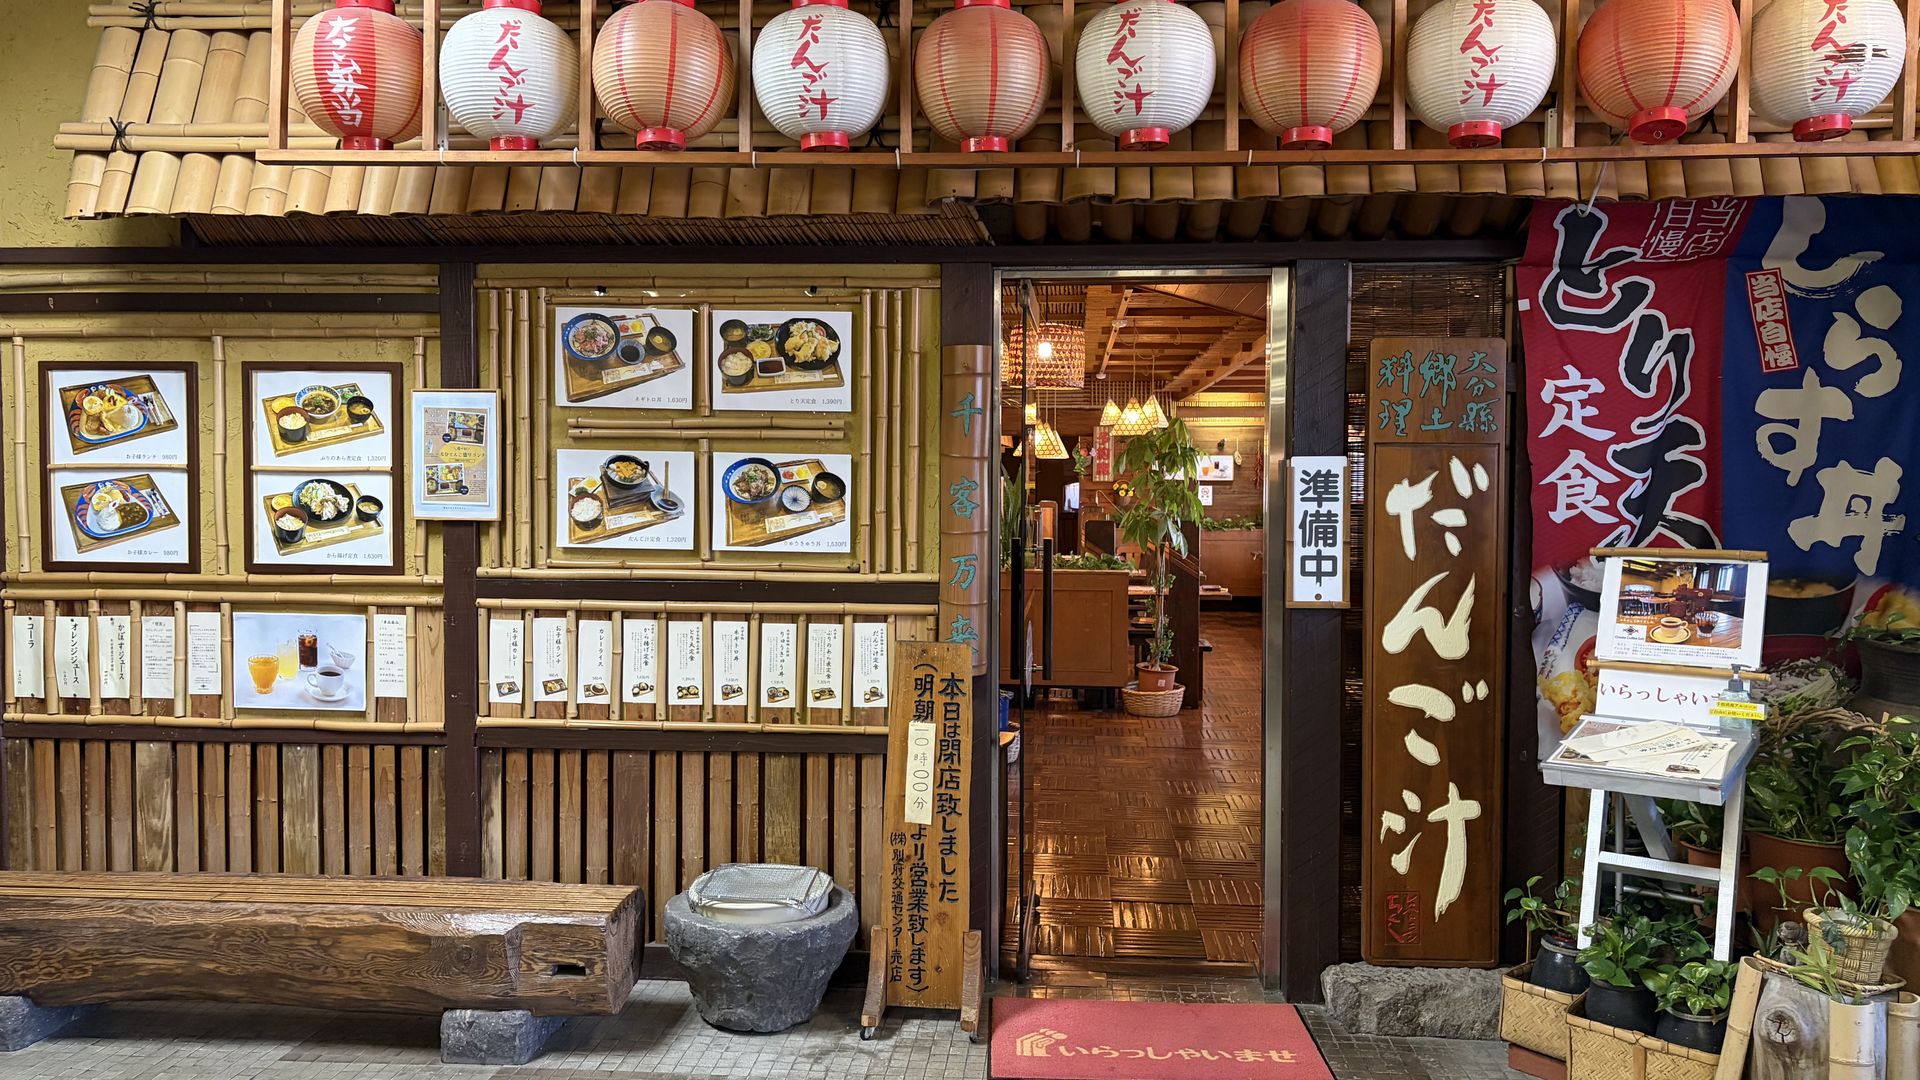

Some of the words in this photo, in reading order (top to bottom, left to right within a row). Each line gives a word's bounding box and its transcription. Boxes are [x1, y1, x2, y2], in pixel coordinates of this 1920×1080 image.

[488, 20, 536, 125] だんご汁
[790, 13, 839, 122] だんご汁
[1106, 7, 1154, 116] だんご汁
[1681, 196, 1738, 257] 当店
[1751, 273, 1796, 370] 当店自慢
[1377, 350, 1415, 437] 料理
[1754, 196, 1907, 576] しらす丼
[1538, 364, 1621, 524] 定食
[1298, 469, 1340, 587] 準備中
[27, 623, 35, 648] コーラ
[71, 622, 80, 684] オレンジジュース
[117, 624, 126, 681] かぼすジュース
[1380, 455, 1490, 923] だんご汁
[936, 672, 966, 903] 本日は閉店致しました
[1059, 1044, 1298, 1063] いらっしゃいませ
